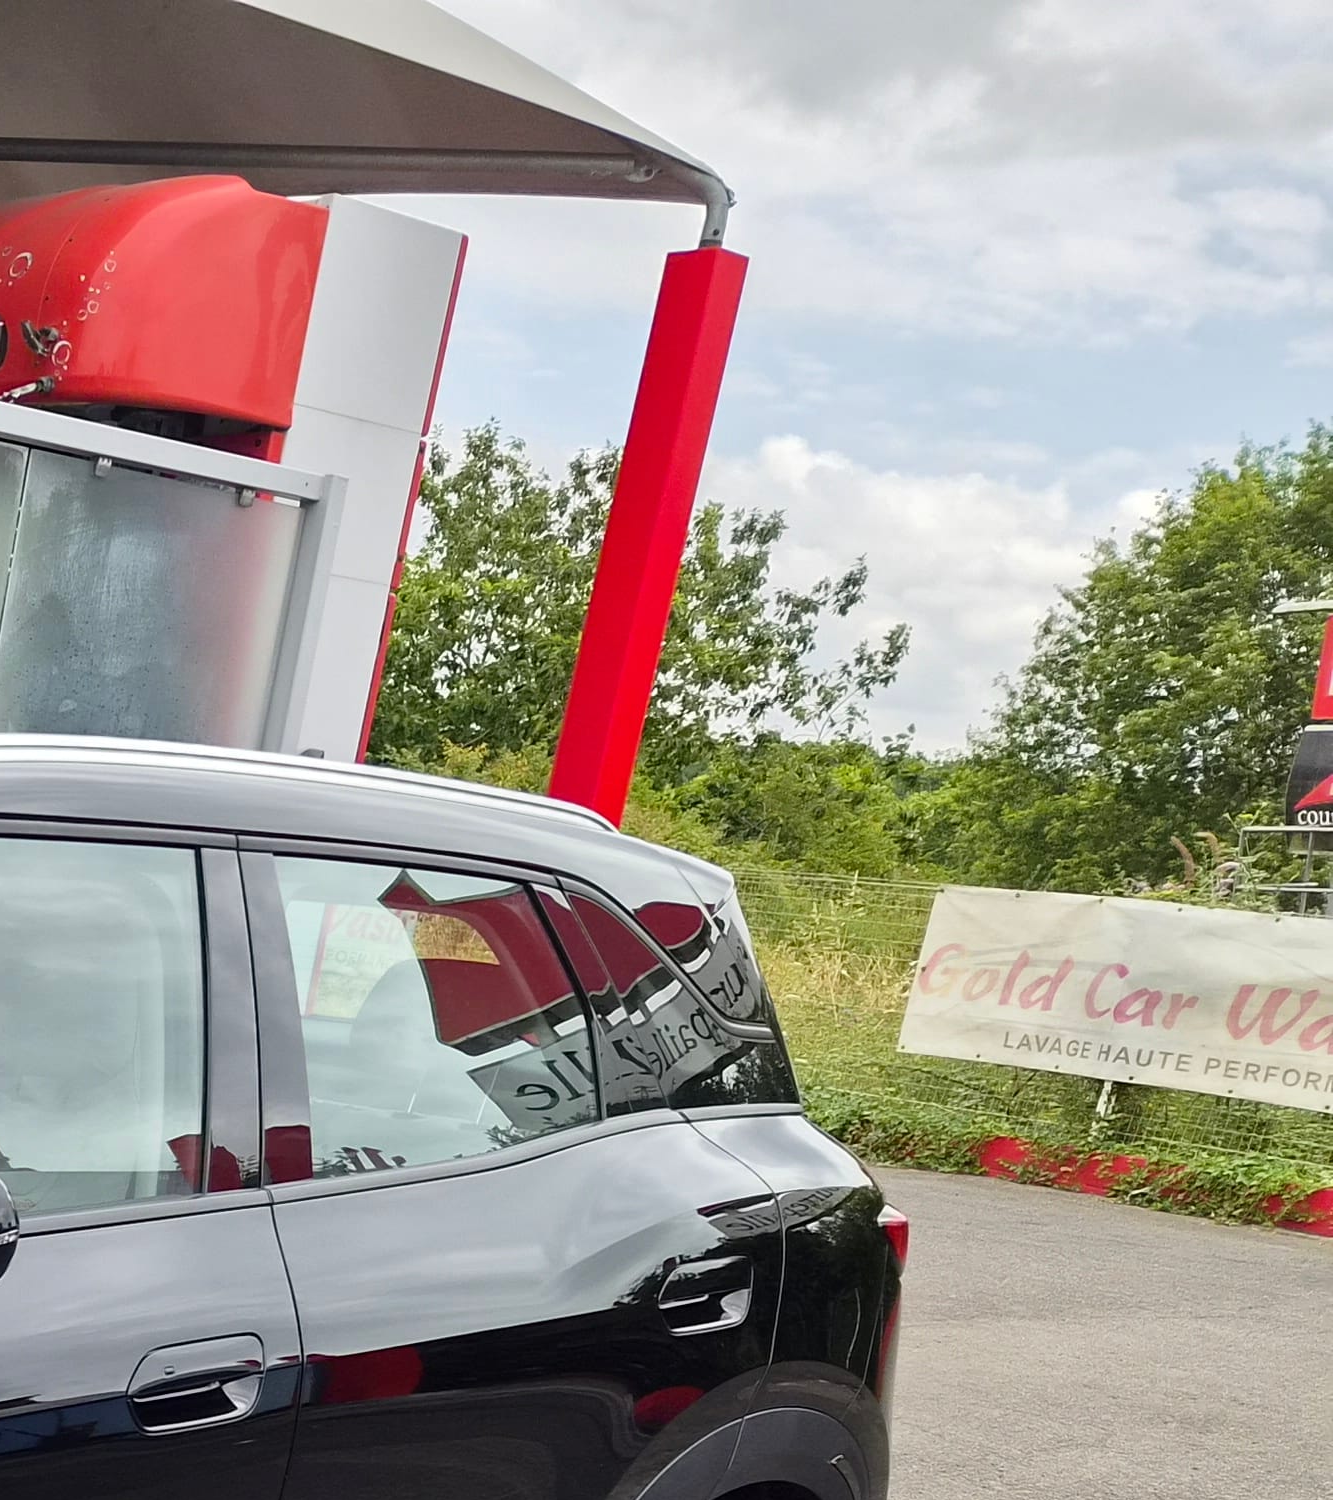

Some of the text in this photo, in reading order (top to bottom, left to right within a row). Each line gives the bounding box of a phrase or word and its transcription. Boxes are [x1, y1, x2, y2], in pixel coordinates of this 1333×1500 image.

[918, 943, 1075, 1012] Gold
[1084, 963, 1200, 1030] Car
[1003, 1032, 1093, 1060] LAVAGE
[1097, 1043, 1193, 1073] HAUTE
